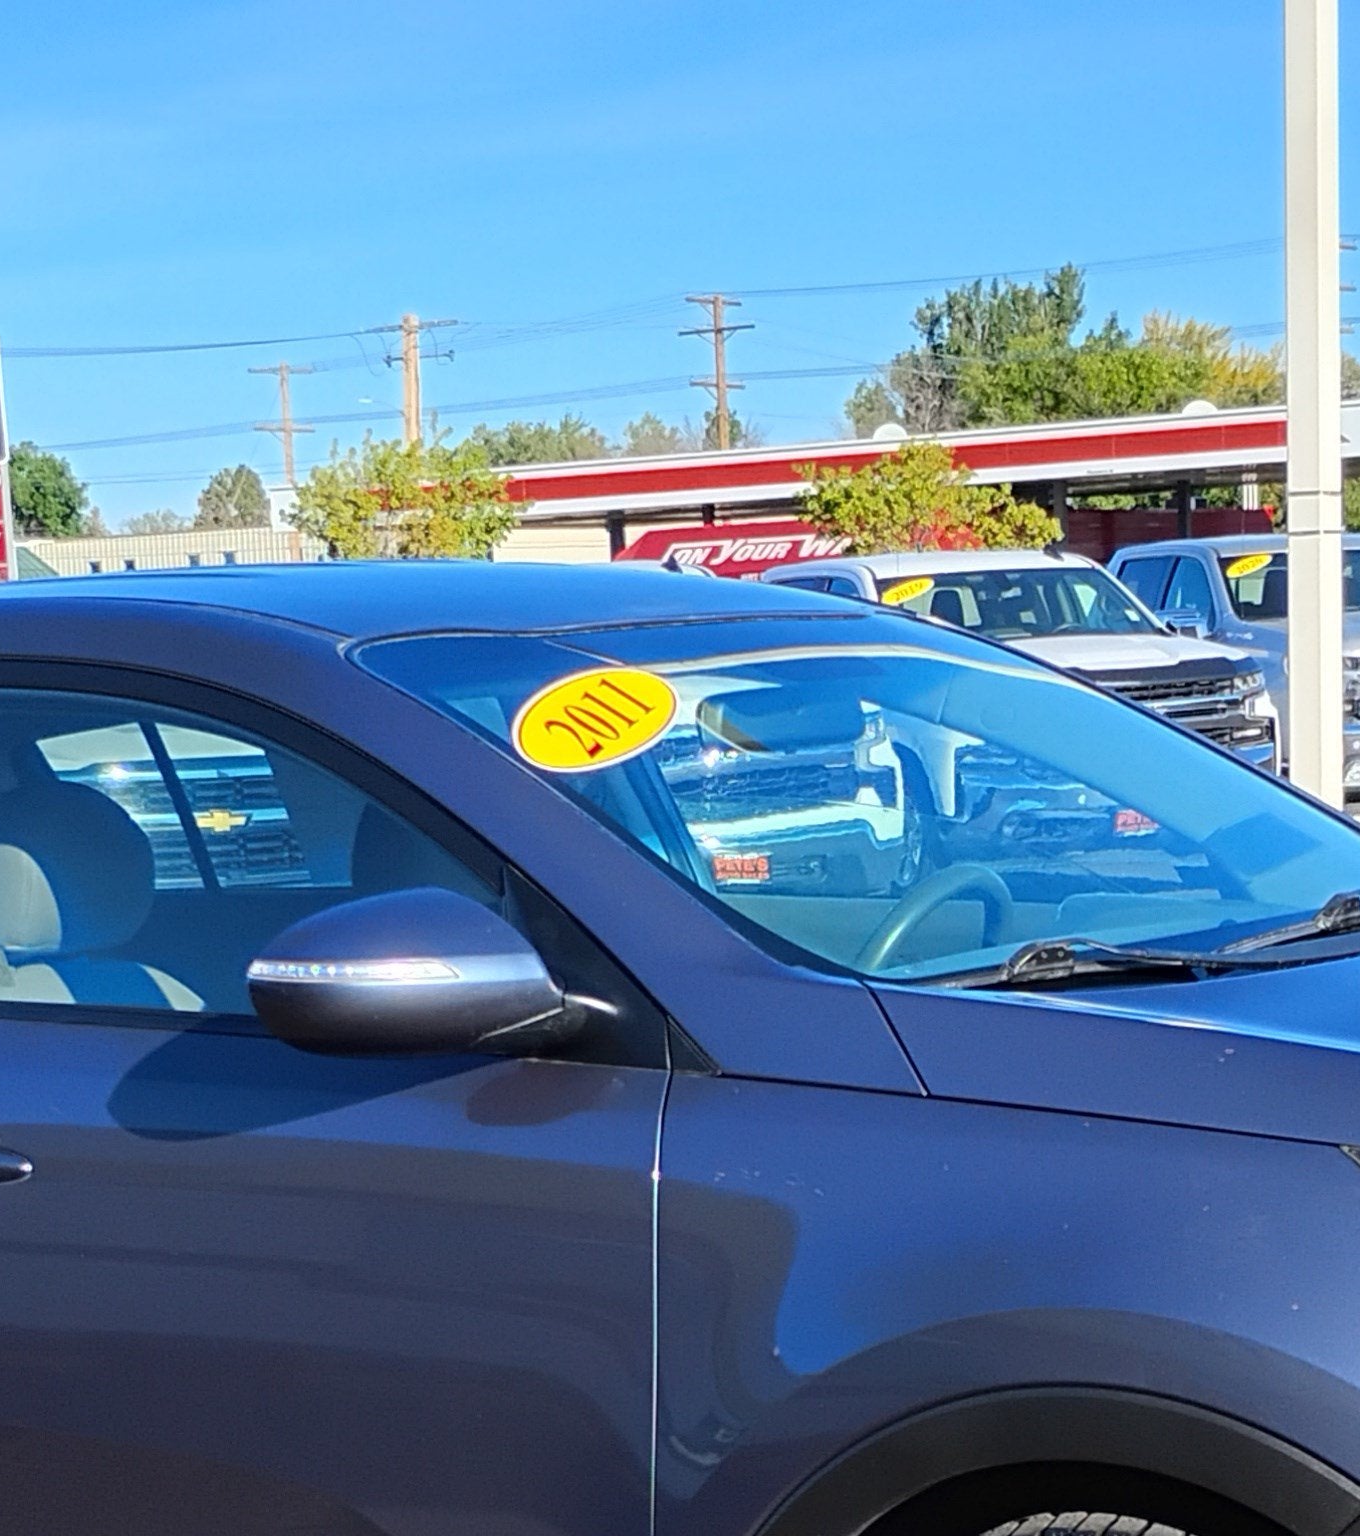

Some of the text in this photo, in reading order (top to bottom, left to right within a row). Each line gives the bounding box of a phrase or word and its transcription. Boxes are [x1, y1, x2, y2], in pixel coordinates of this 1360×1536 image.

[677, 547, 712, 565] ON
[709, 539, 793, 566] YOUR
[543, 677, 656, 759] 2011
